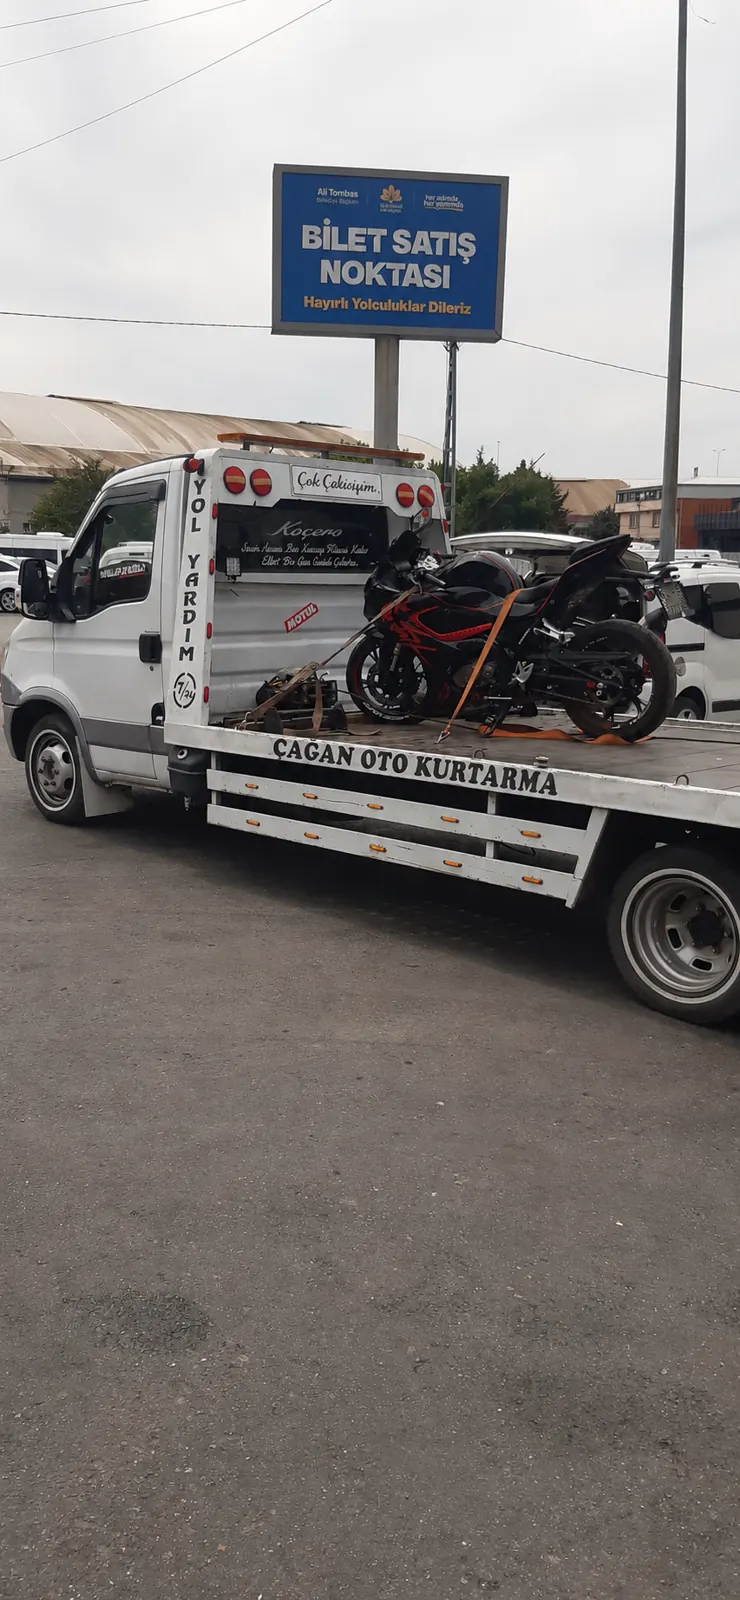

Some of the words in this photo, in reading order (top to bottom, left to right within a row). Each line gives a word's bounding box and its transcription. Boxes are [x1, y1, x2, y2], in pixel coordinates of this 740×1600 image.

[317, 188, 328, 196] Ali
[302, 218, 387, 253] BİLET
[392, 229, 476, 264] SATIŞ
[320, 259, 451, 289] NOKTASI
[303, 296, 349, 311] Hayırlı
[351, 298, 427, 313] Yolculuklar
[428, 301, 472, 315] Dileriz
[297, 471, 320, 490] Çok
[191, 478, 206, 533] YOL
[267, 520, 342, 540] Koçero
[179, 554, 201, 662] YARDIM
[286, 603, 317, 631] MOTUL
[177, 681, 194, 701] 7/24
[272, 737, 355, 767] ÇAĞAN
[360, 749, 408, 774] OTO
[414, 756, 559, 796] KURTARMA
